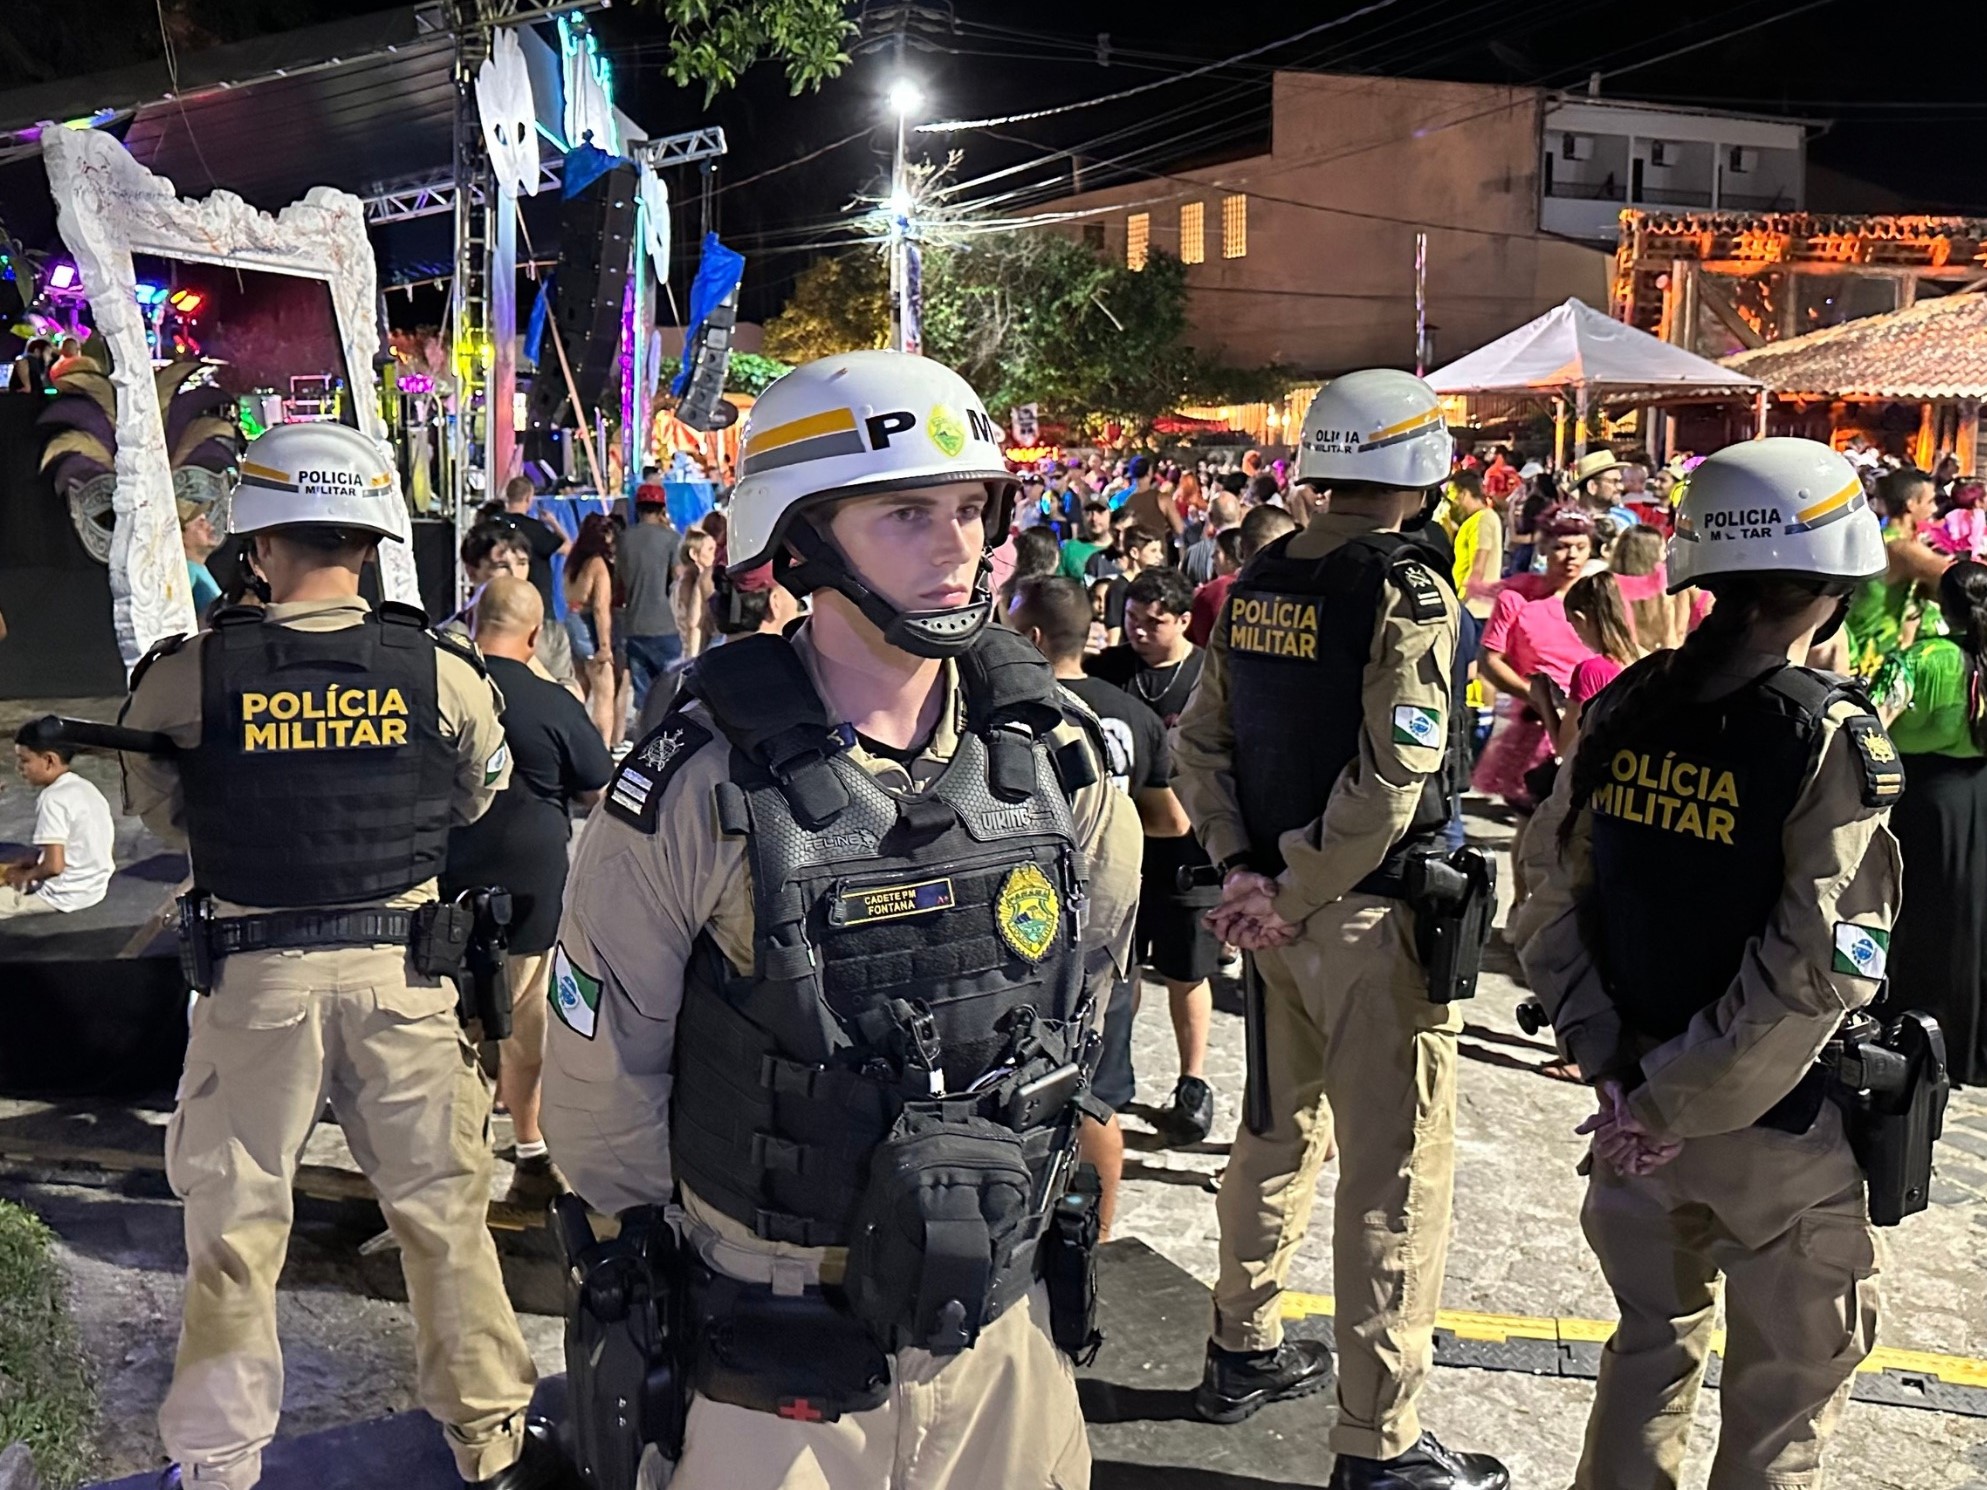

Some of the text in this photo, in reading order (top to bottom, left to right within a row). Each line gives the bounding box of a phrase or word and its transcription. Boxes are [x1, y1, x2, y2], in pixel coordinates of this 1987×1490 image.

[865, 408, 995, 451] P M
[1314, 429, 1360, 444] OLIIA
[298, 470, 363, 487] POLICIA
[1704, 508, 1781, 529] POLICIA
[1710, 527, 1772, 541] MLTAR
[1231, 596, 1317, 630] POLÍCIA
[1230, 624, 1316, 659] MILITAR
[242, 683, 409, 721] POLÍCIA
[244, 718, 408, 751] MILITAR
[1610, 749, 1739, 807] OLÍCIA
[981, 808, 1031, 830] VIKING
[1591, 782, 1735, 845] MILITAR
[804, 833, 860, 851] FELINE
[864, 889, 917, 905] CADETE PM
[868, 900, 916, 916] FONTANA
